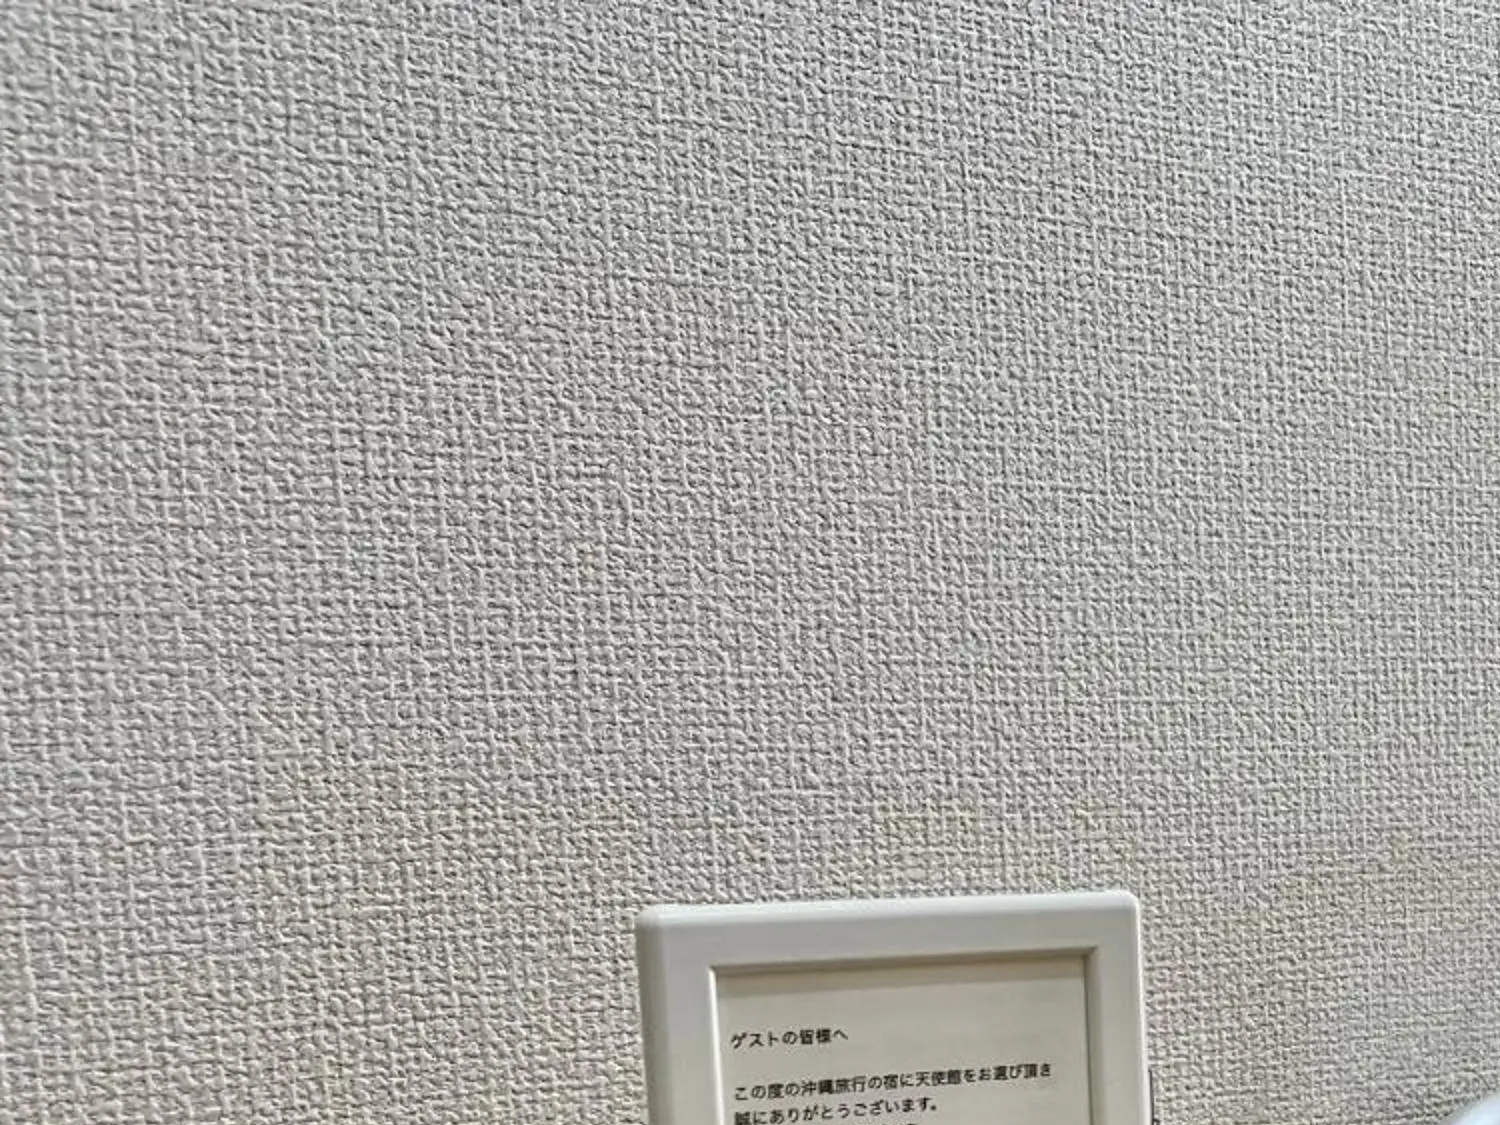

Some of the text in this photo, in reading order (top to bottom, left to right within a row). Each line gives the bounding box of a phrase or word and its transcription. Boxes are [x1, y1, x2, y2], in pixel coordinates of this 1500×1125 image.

[731, 1029, 849, 1049] ゲストの皆様へ
